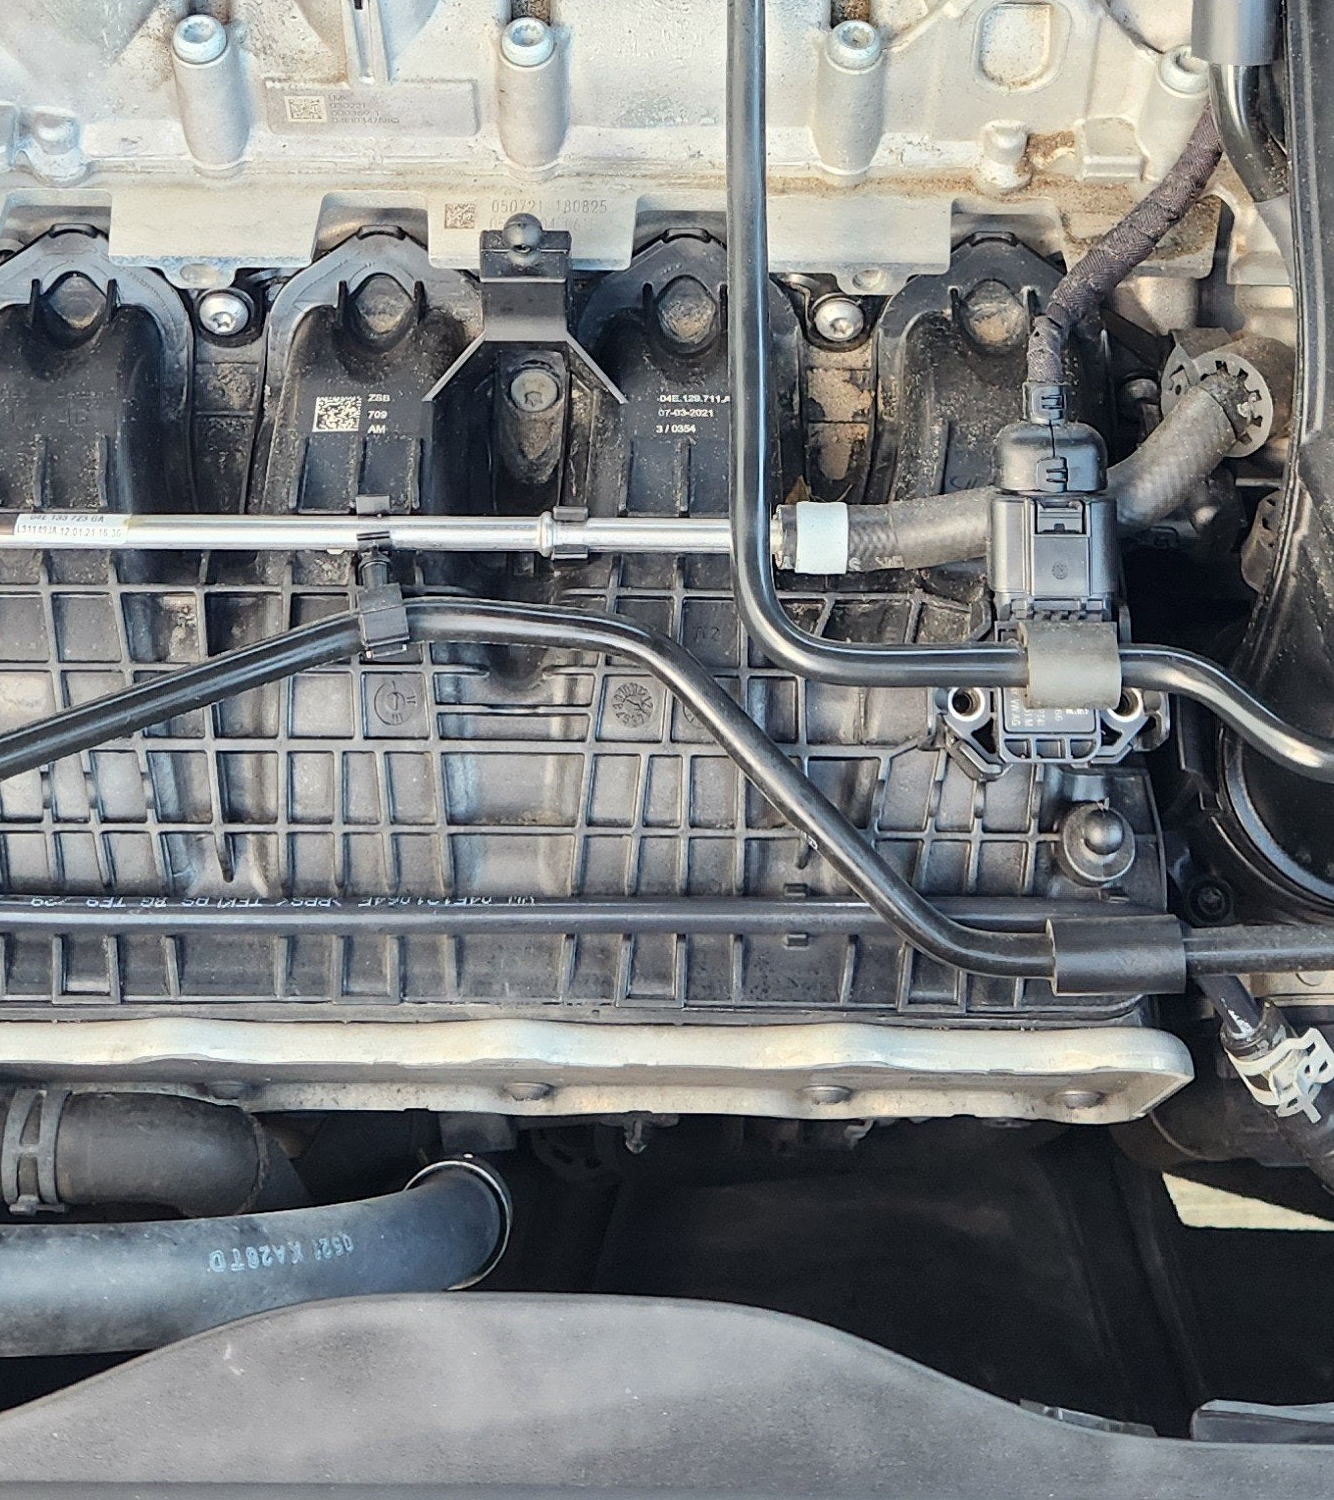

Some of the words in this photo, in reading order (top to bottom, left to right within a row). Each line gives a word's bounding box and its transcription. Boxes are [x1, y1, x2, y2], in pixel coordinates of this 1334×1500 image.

[490, 198, 543, 214] 050721
[366, 409, 388, 419] 709
[657, 407, 713, 417] 07-03-2021
[366, 424, 386, 434] AM
